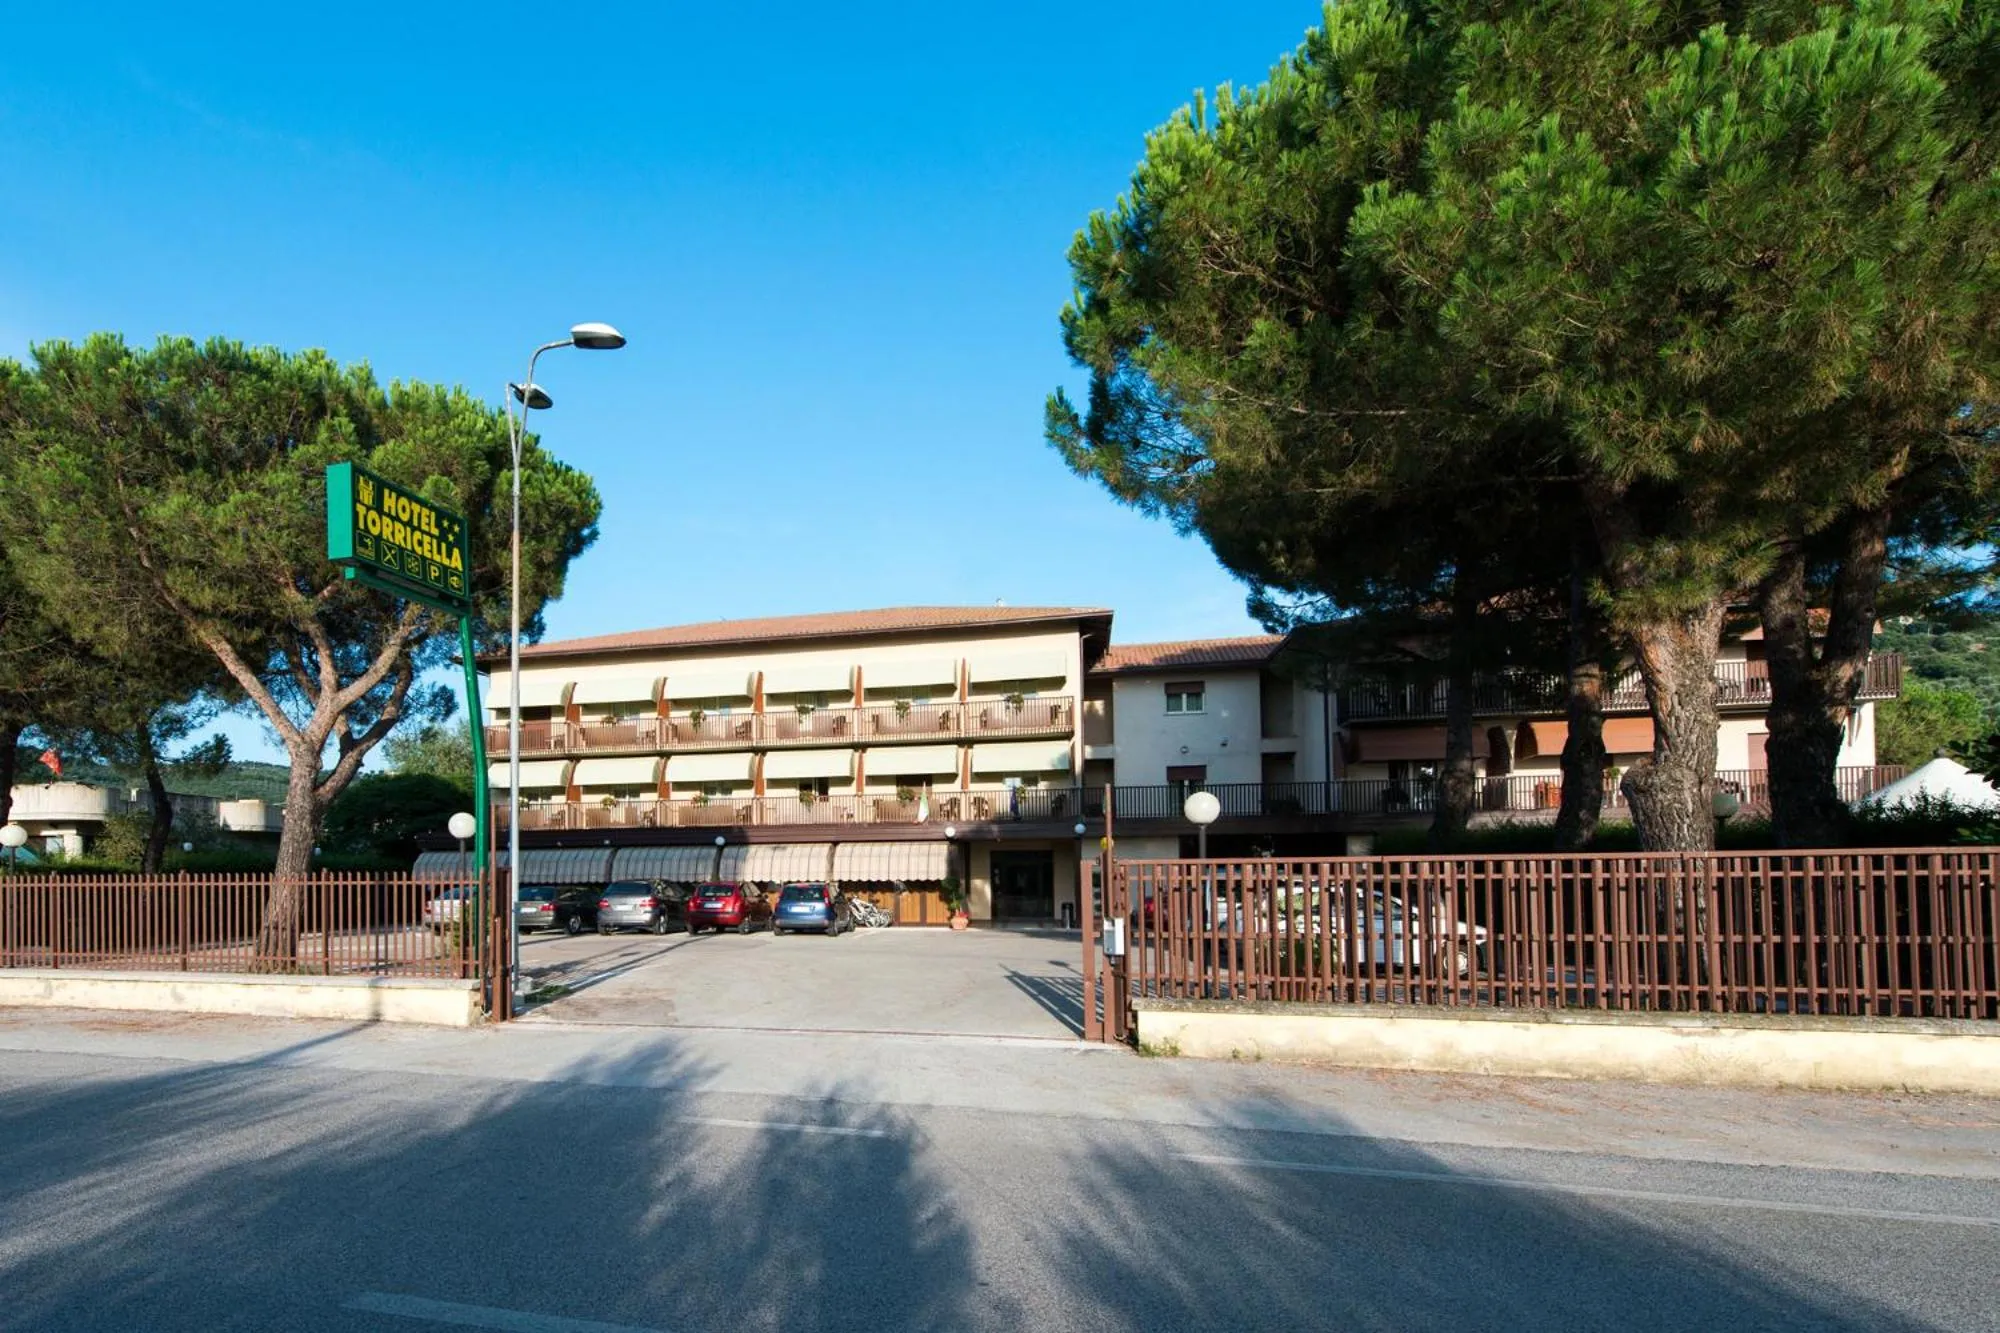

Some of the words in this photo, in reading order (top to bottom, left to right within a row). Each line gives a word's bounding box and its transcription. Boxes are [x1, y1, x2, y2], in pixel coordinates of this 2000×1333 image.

[356, 503, 463, 571] TORRICELLA
[384, 488, 439, 537] HOTEL
[430, 565, 439, 580] P
